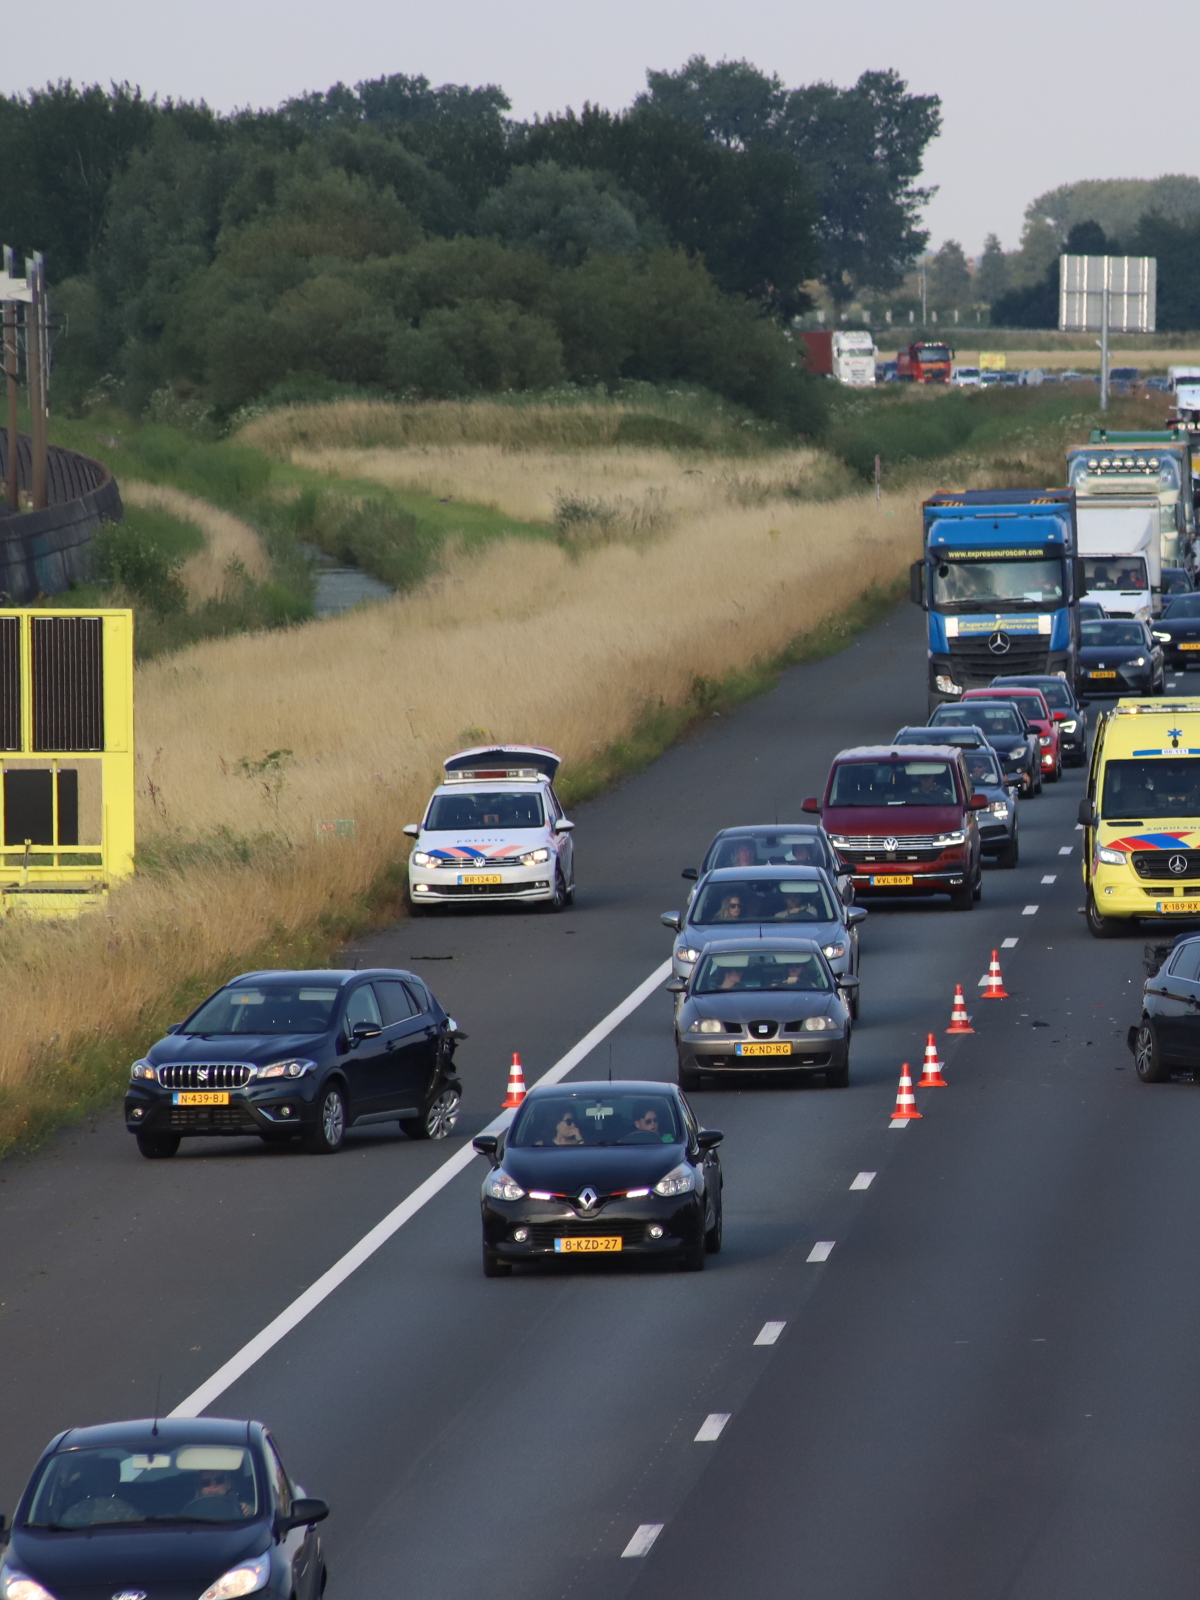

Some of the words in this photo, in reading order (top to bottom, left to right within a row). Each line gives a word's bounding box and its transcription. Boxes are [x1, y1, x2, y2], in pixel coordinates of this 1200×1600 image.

[948, 549, 1044, 559] www.expresseuroscan.com
[464, 876, 498, 884] RR-124-D
[876, 876, 910, 884] VVL-86-P
[1163, 903, 1198, 911] K-189-RX
[743, 1045, 789, 1054] 96-ND-RG
[181, 1094, 224, 1103] N-439-BJ
[565, 1239, 618, 1250] 8-KZD-27
